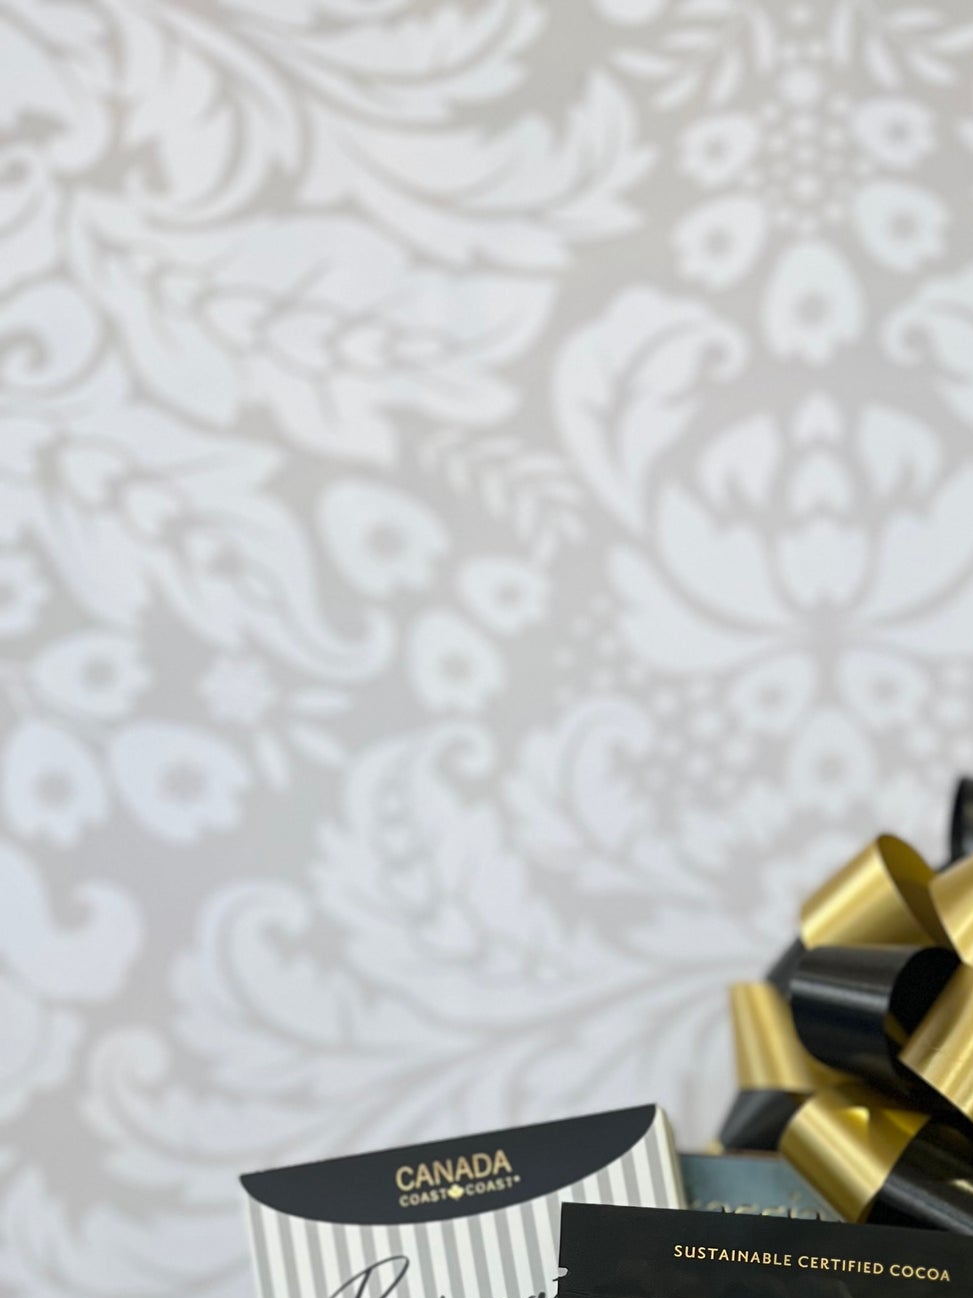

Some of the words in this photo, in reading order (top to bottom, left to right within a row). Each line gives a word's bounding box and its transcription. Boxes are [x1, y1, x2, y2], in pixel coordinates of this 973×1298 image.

[395, 1149, 512, 1191] CANADA
[399, 1188, 448, 1207] COAST
[673, 1244, 792, 1267] SUSTAINABLE
[798, 1255, 884, 1276] CERTIFIED
[889, 1263, 951, 1282] COCOA
